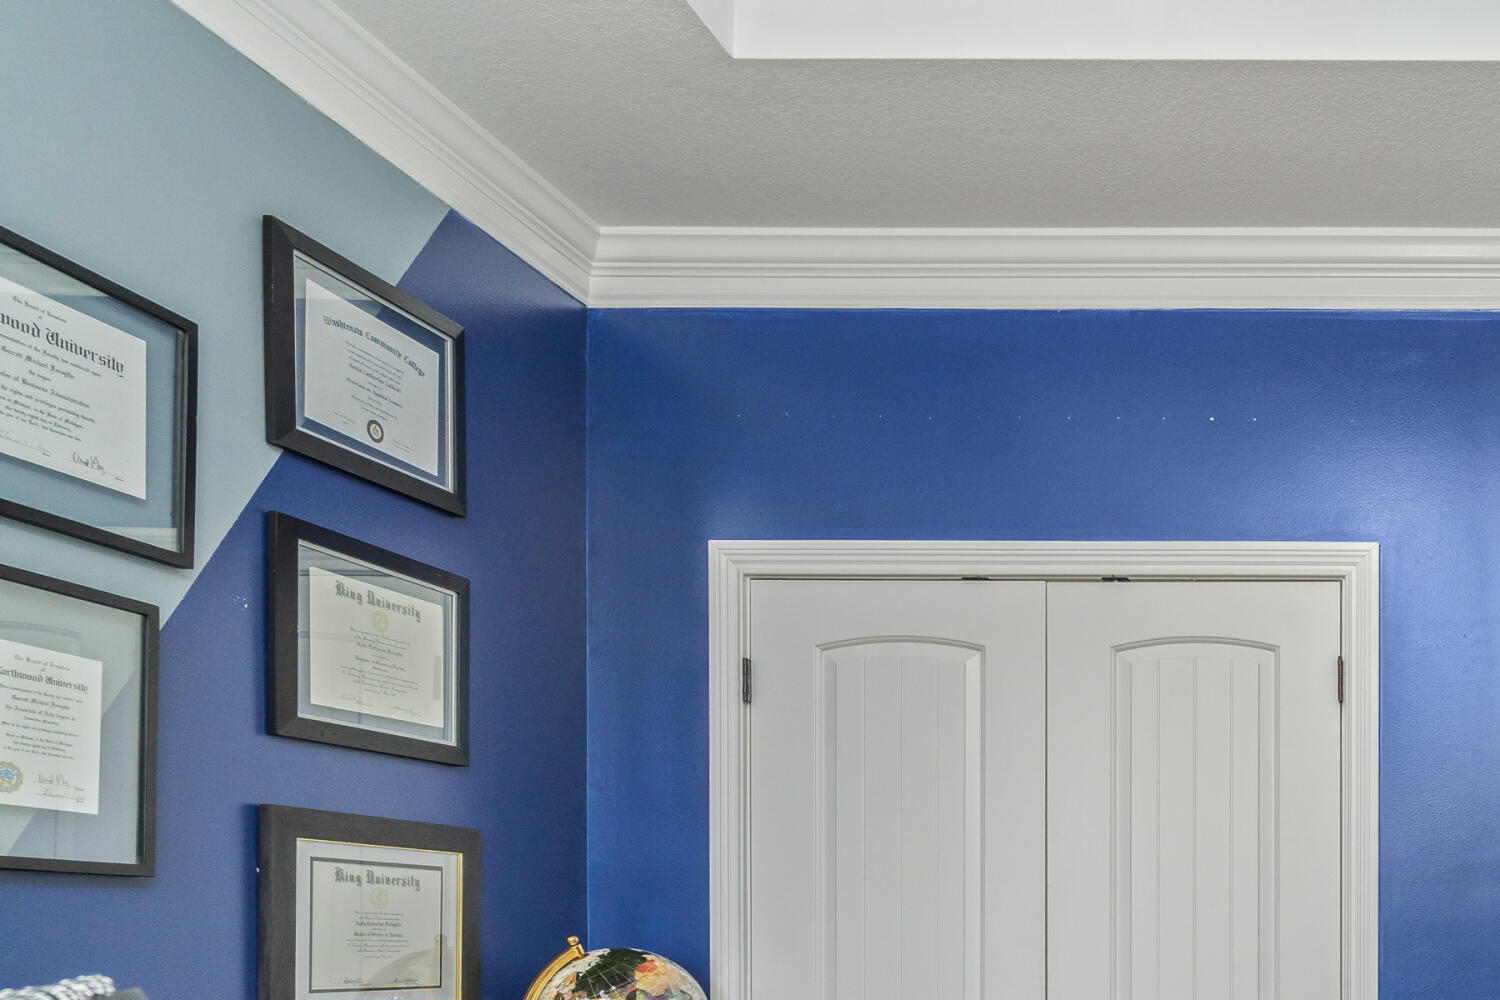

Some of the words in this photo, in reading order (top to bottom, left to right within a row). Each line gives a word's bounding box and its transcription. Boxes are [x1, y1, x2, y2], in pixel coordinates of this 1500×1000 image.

[46, 327, 124, 378] University
[365, 332, 402, 358] Community
[403, 355, 425, 377] College
[367, 590, 421, 623] University
[45, 676, 88, 694] University
[335, 867, 362, 886] King
[366, 870, 420, 891] University
